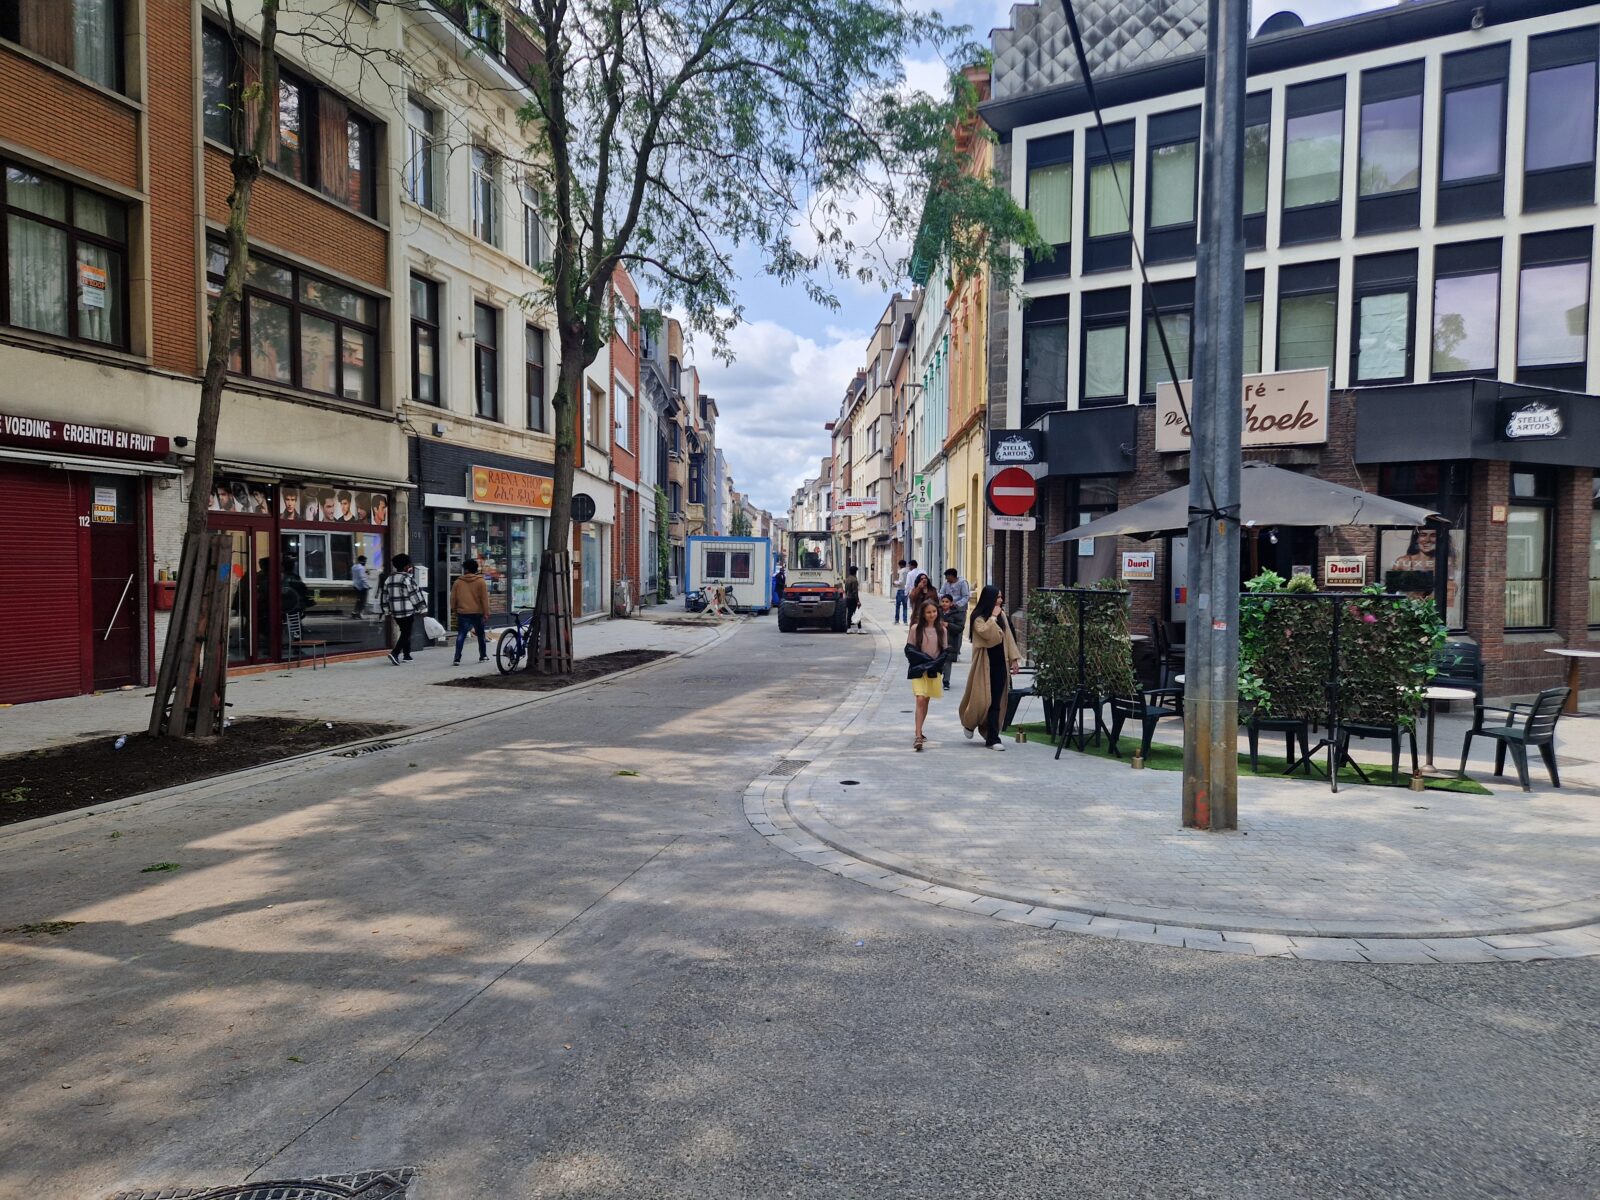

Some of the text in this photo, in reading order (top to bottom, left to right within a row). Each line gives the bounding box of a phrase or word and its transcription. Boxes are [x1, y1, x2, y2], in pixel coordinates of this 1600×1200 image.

[1165, 411, 1183, 426] De
[1517, 416, 1550, 424] STELLA
[1517, 423, 1551, 431] ARTOIS
[5, 416, 50, 439] VOEDING
[63, 423, 114, 447] GROENTEN
[116, 431, 128, 448] EN
[129, 433, 156, 452] FRUIT
[488, 470, 543, 490] RAENA SHOP
[78, 515, 91, 528] 112
[1127, 558, 1150, 568] Duvel
[1330, 563, 1361, 574] Duvel
